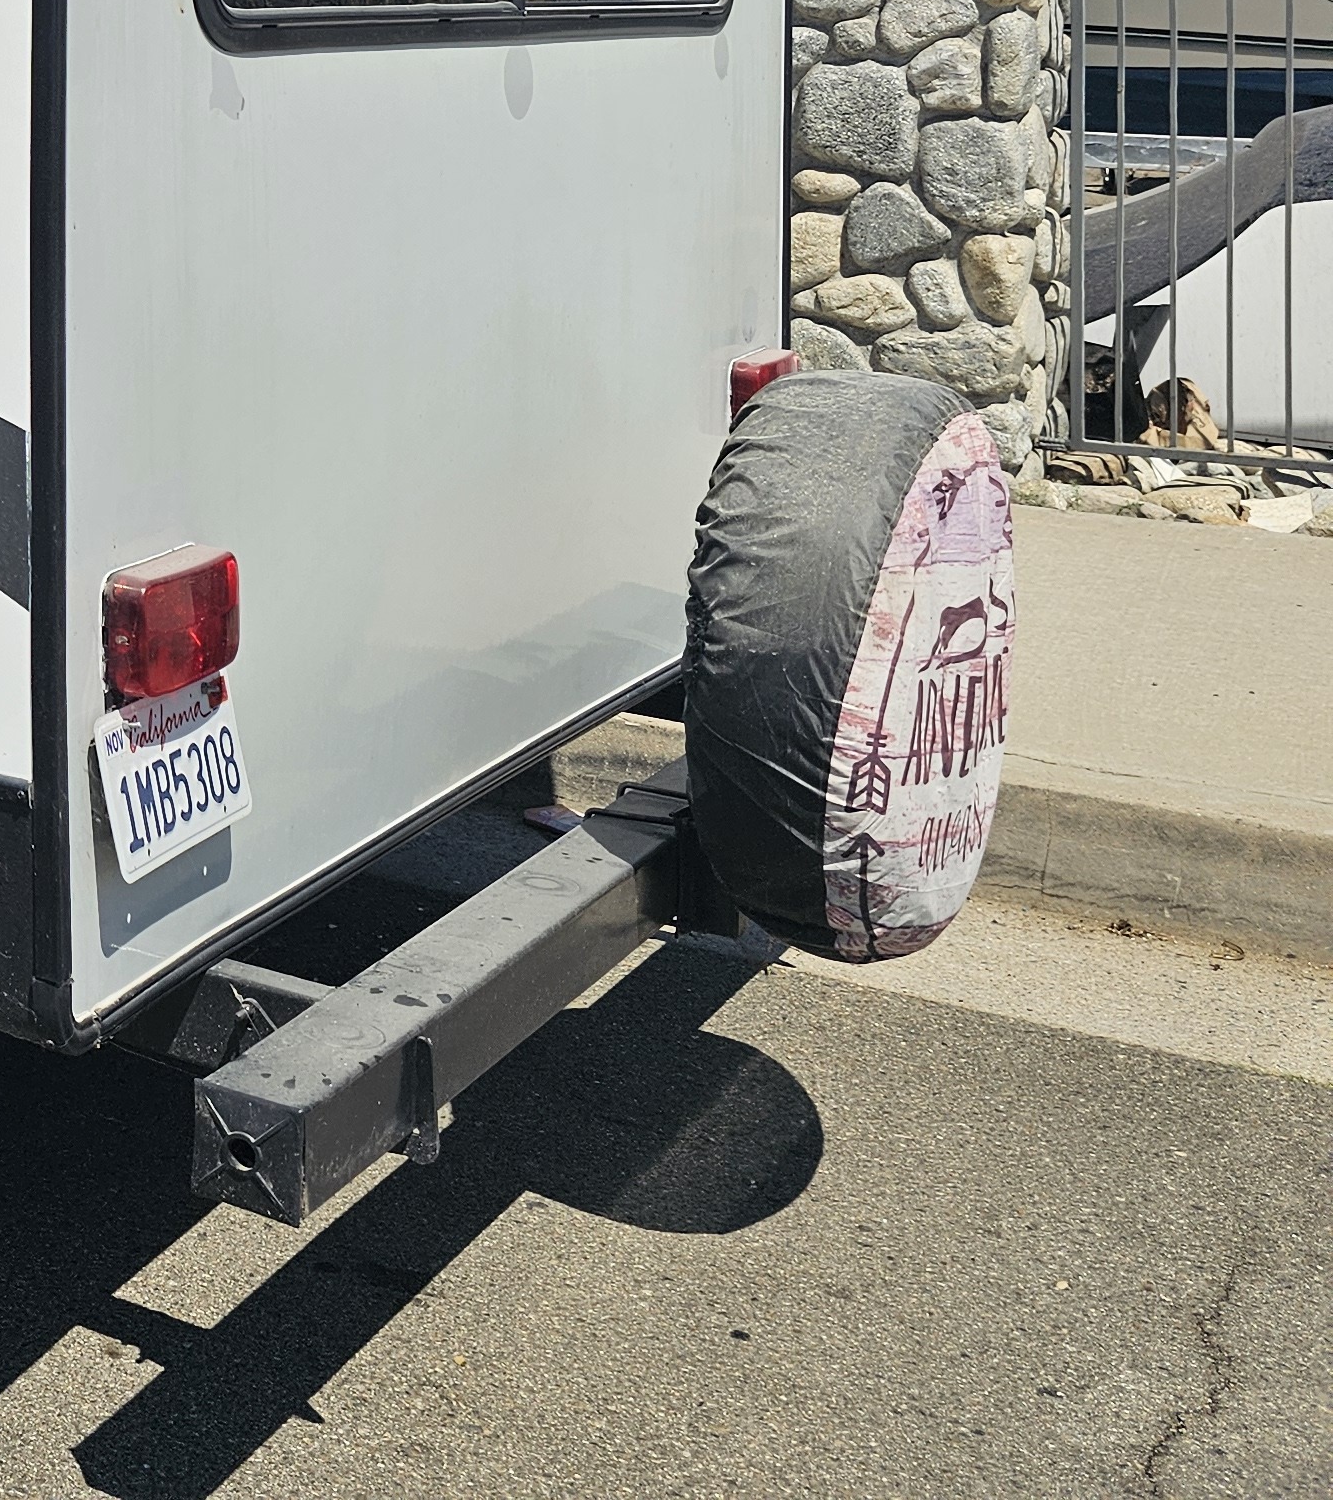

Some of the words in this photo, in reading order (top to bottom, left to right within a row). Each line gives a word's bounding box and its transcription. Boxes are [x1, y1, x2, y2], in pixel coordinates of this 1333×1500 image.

[105, 729, 124, 757] NOV
[128, 694, 213, 754] California
[119, 725, 241, 854] 1MB5308
